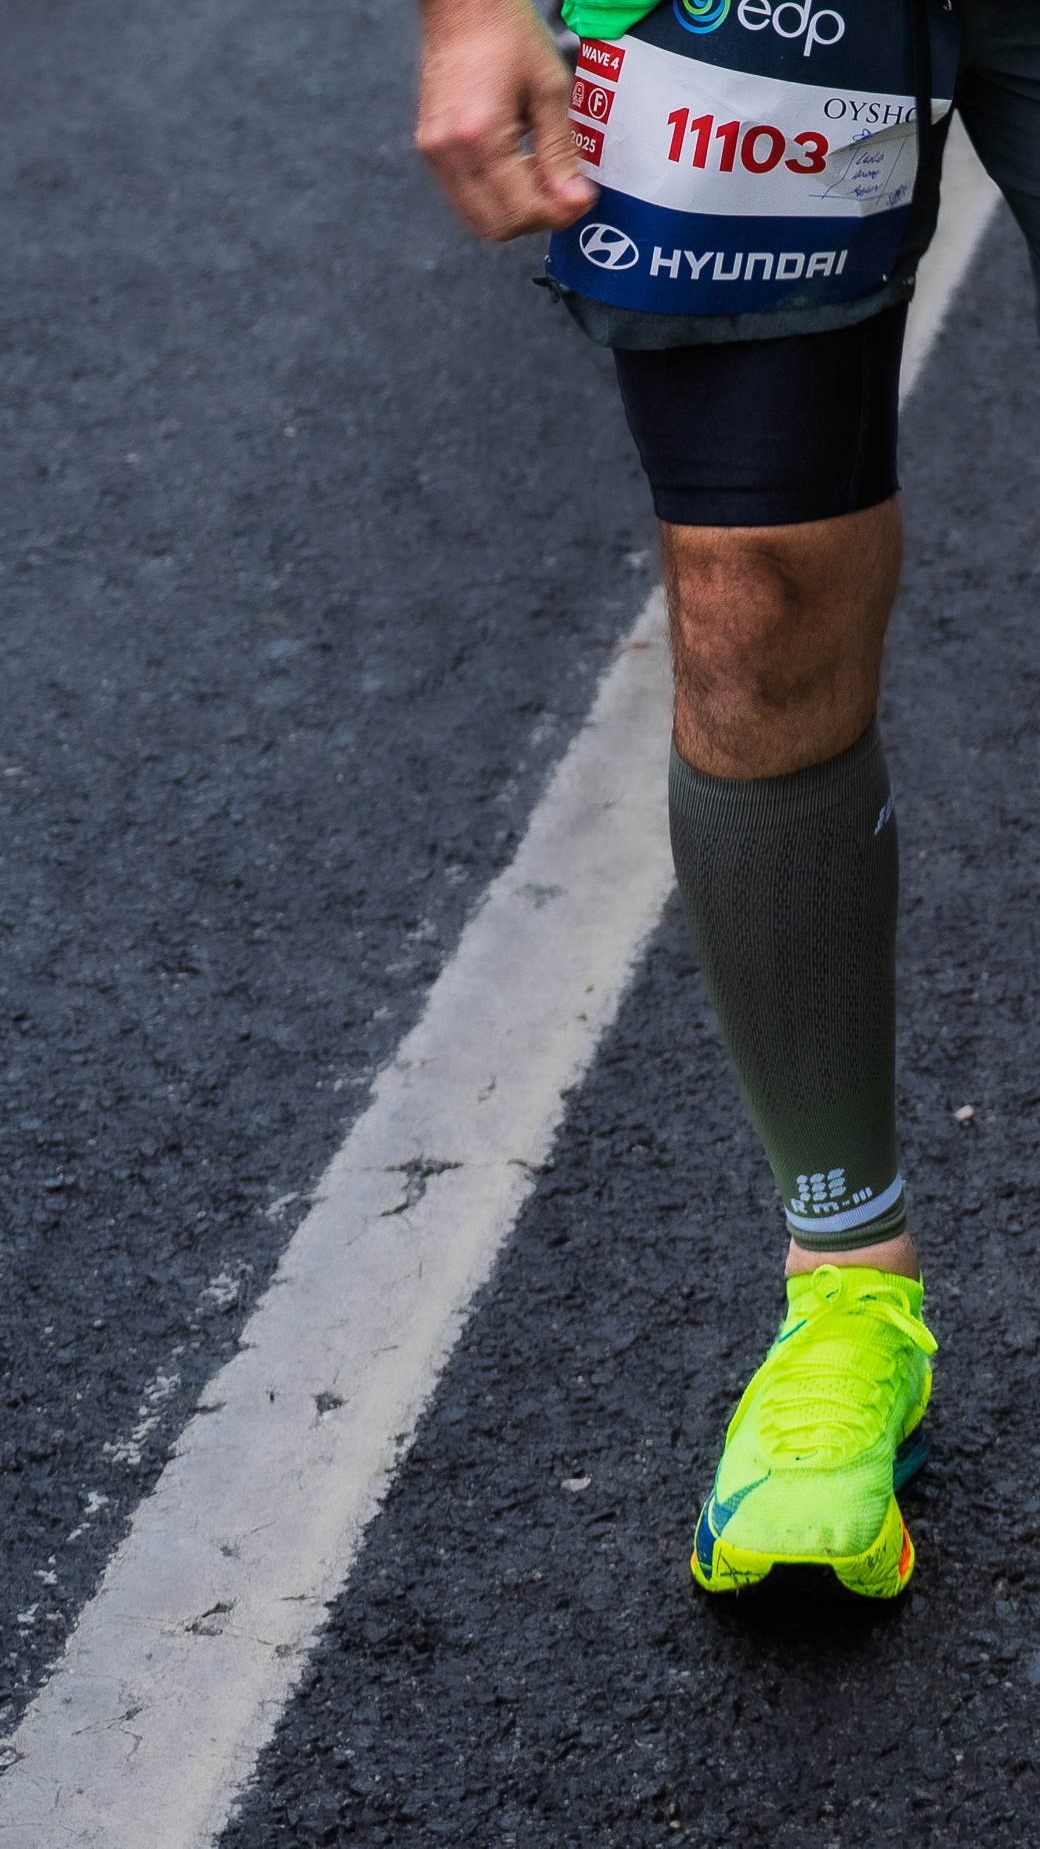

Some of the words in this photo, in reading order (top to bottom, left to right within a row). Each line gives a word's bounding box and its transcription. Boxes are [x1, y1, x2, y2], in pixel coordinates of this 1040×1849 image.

[581, 43, 611, 68] WAVE
[611, 56, 620, 71] 4
[593, 92, 604, 112] F
[570, 129, 597, 154] 2025
[666, 106, 830, 175] 11103
[649, 246, 849, 281] HYUNDAI
